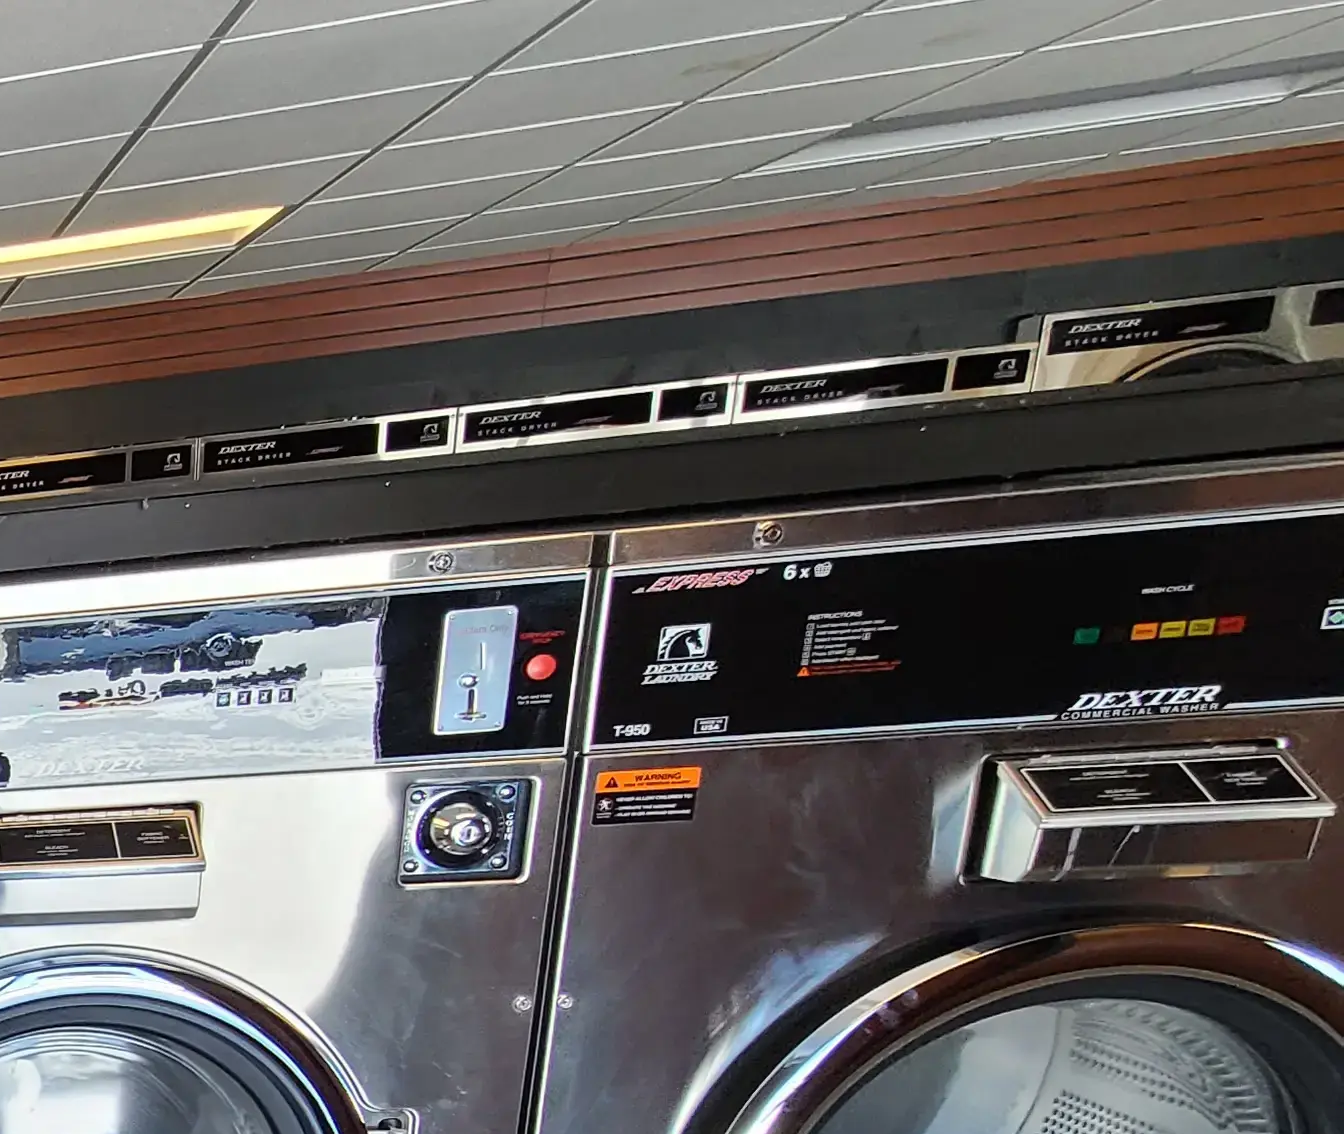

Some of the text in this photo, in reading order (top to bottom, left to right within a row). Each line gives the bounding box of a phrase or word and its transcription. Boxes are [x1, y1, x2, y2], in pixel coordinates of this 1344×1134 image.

[1068, 318, 1142, 334] DEXTER
[1064, 330, 1160, 347] STACK DRYER
[760, 379, 827, 394] DEXTER
[757, 396, 796, 406] STACK
[479, 411, 542, 425] DEXTER
[477, 427, 513, 437] STACK
[218, 441, 276, 454] DEXTER
[217, 451, 291, 466] STACK DRYER
[13, 481, 44, 489] DRYER
[783, 565, 796, 580] 6
[646, 568, 755, 593] EXPRESS
[643, 661, 718, 675] DEXTER
[641, 672, 716, 685] LAUNDRY
[1067, 685, 1222, 711] DEXTER
[1061, 702, 1220, 720] COMMERCIAL WASHER
[613, 723, 651, 737] T-950
[635, 772, 682, 783] WARNING
